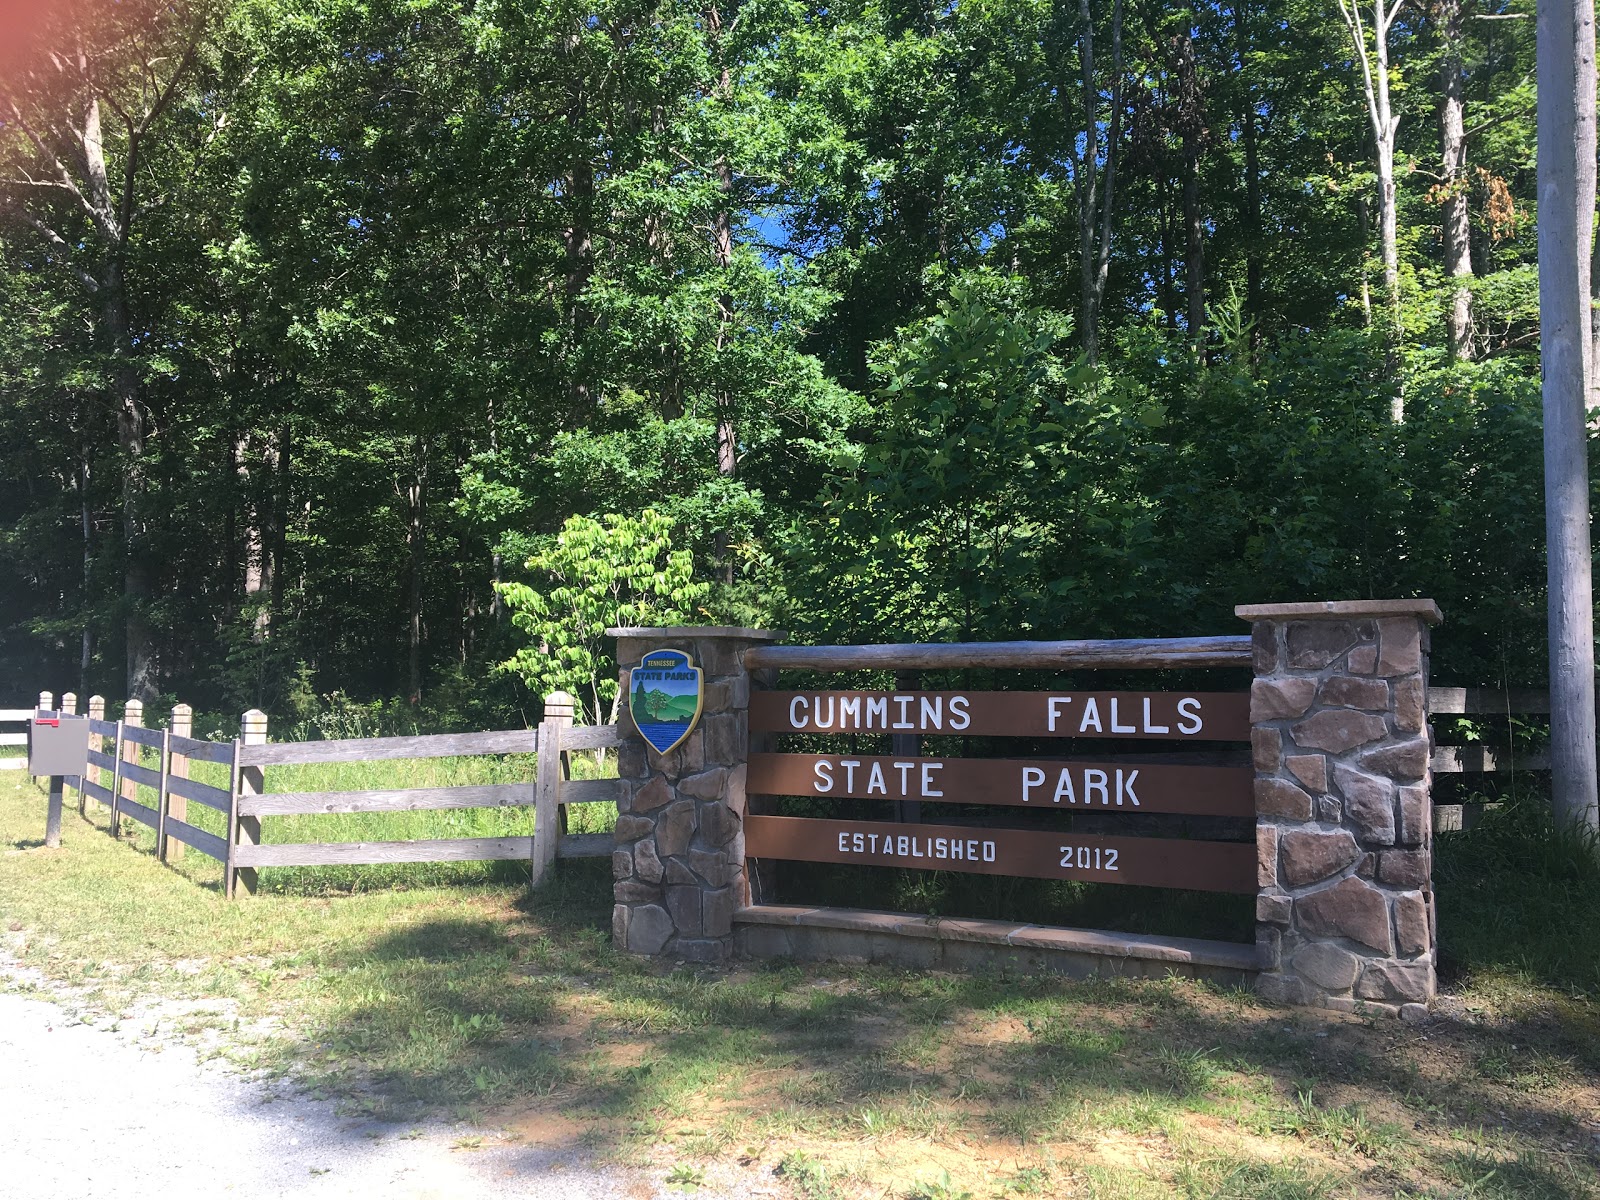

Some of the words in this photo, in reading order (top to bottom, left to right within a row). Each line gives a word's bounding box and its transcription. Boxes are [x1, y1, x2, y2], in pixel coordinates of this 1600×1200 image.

[634, 672, 662, 680] STATE
[665, 672, 696, 680] PARKS
[789, 695, 971, 730] CUMMINS
[1047, 696, 1204, 735] FALLS
[813, 759, 944, 797] STATE
[1021, 767, 1140, 806] PARK
[838, 832, 996, 863] ESTABLISHED
[1059, 846, 1119, 872] 2012
